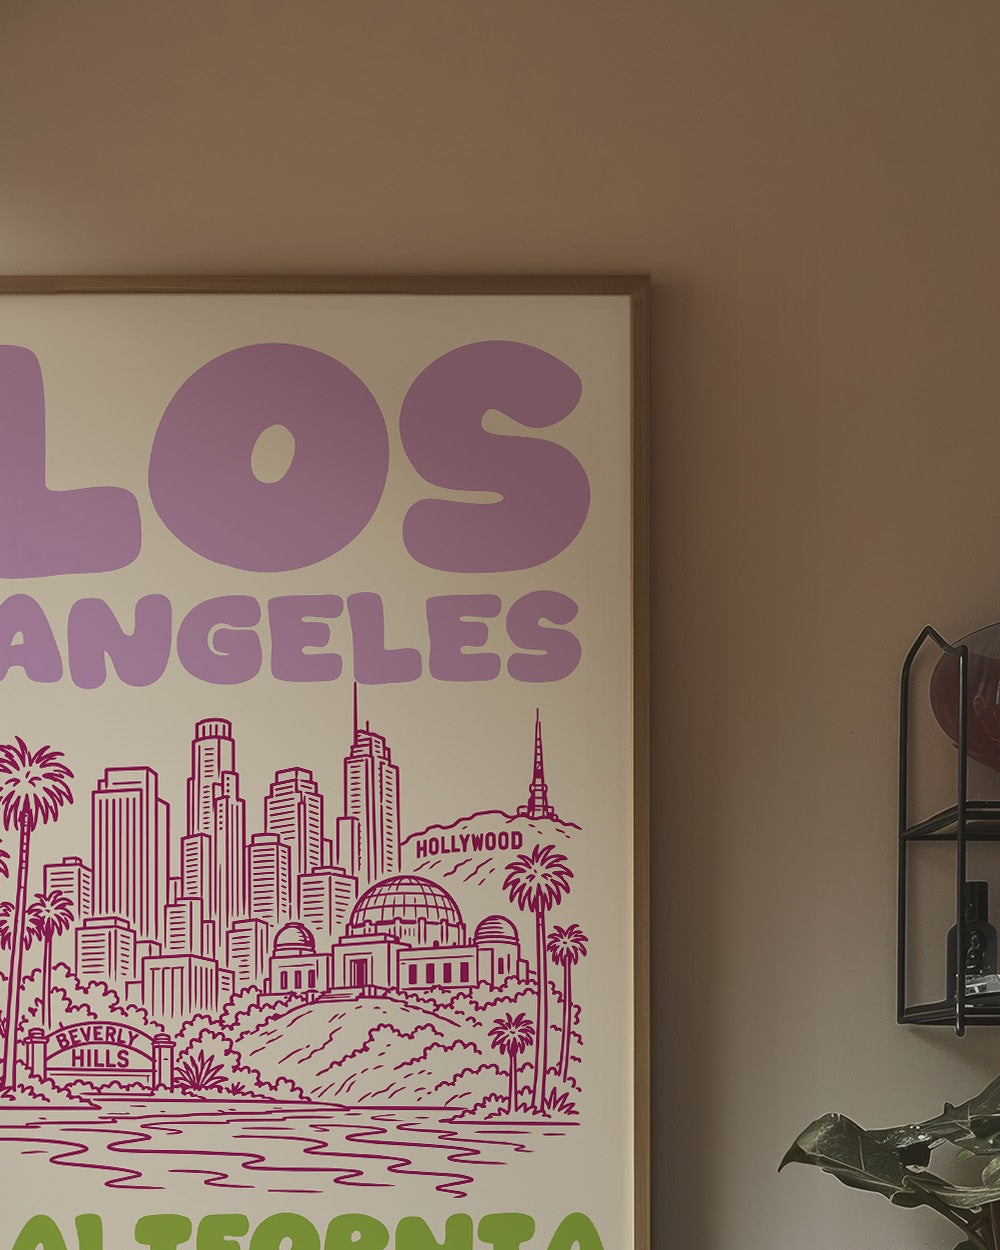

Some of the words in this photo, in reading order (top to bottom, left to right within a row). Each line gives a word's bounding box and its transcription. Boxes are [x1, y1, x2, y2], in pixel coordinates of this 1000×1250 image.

[416, 831, 523, 858] HOLLYWOOD
[55, 1026, 139, 1050] BEVERLY
[72, 1049, 129, 1067] HILLS
